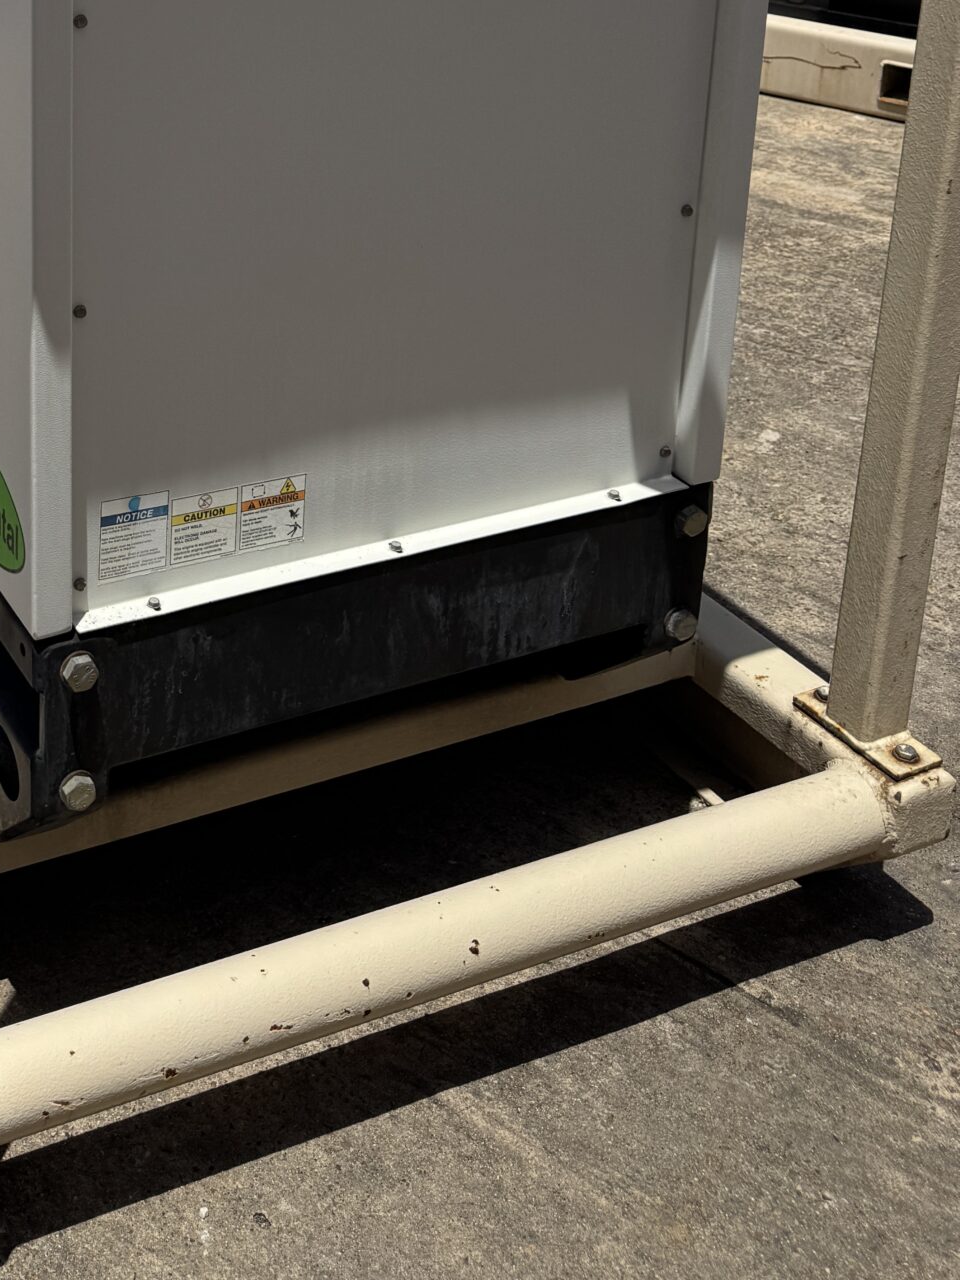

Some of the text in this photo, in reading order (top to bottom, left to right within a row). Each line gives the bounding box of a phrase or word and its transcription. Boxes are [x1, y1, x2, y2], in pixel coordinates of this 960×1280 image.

[258, 492, 299, 509] WARNING
[116, 509, 153, 524] NOTICE
[183, 507, 226, 523] CAUTION
